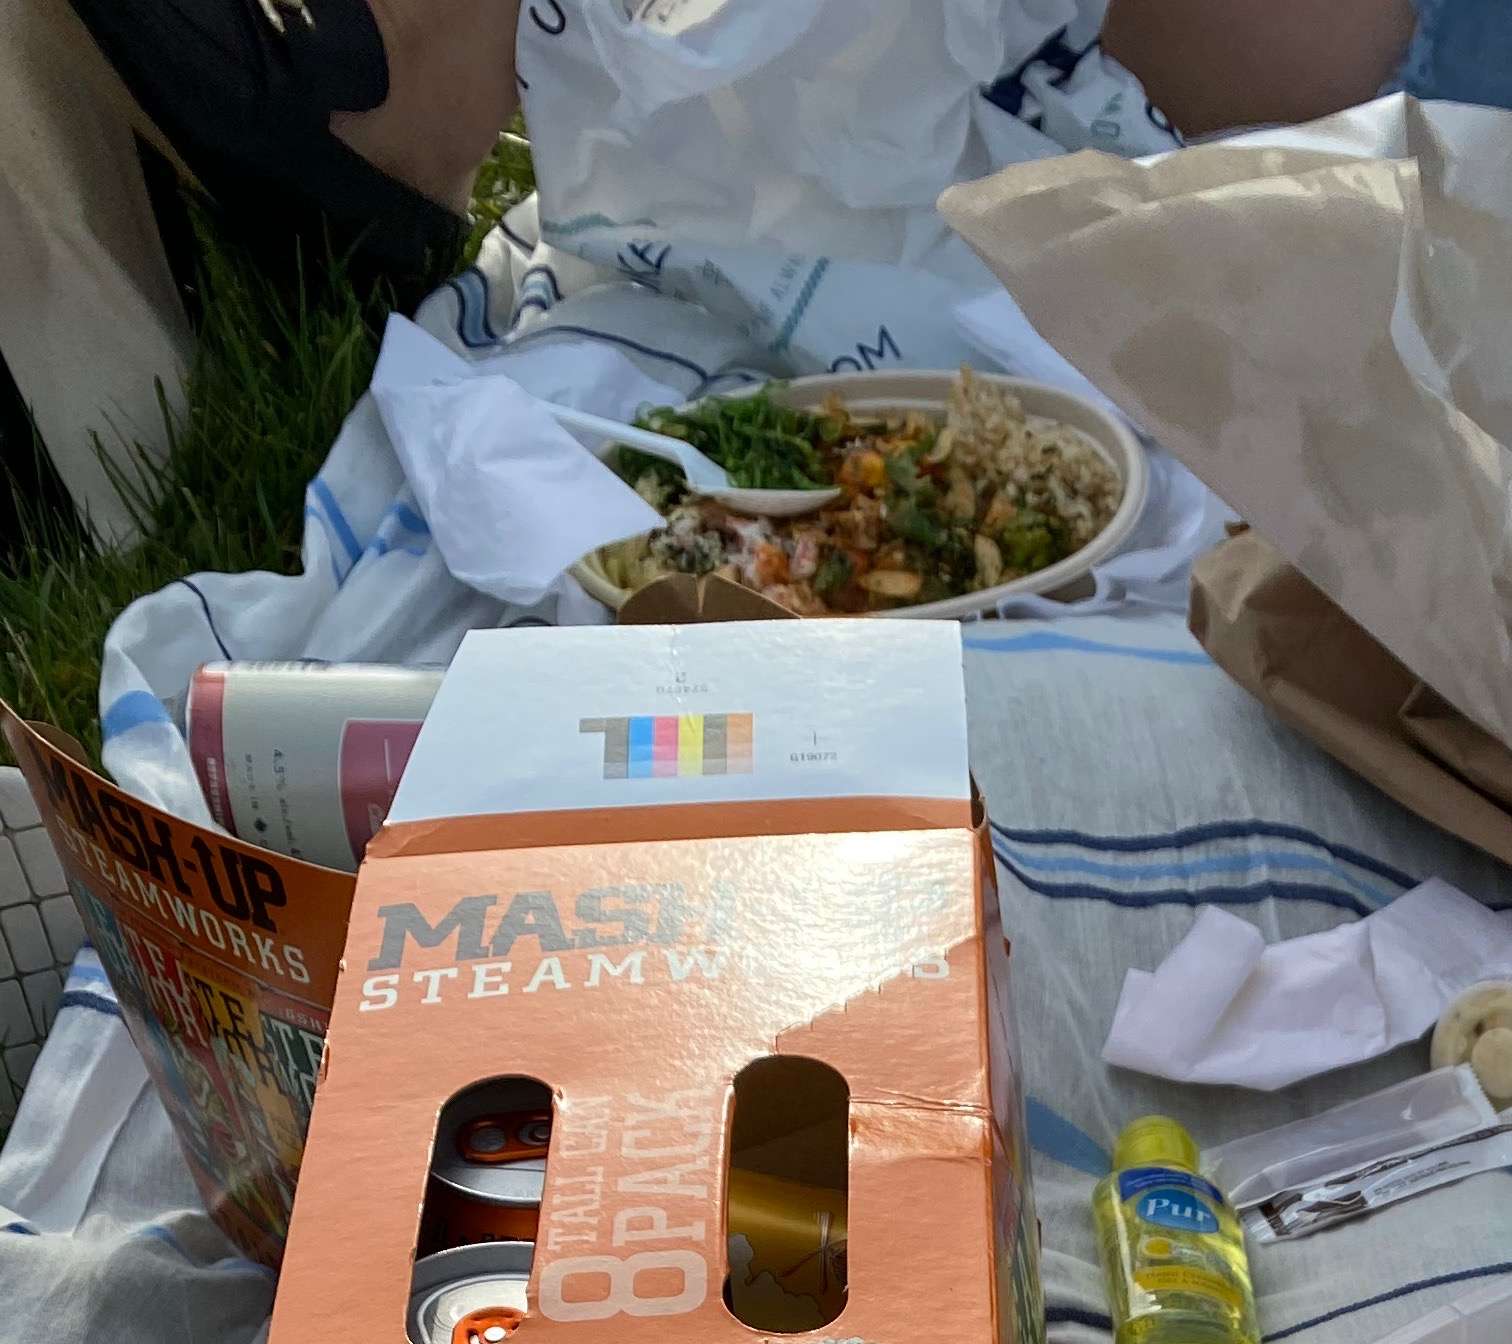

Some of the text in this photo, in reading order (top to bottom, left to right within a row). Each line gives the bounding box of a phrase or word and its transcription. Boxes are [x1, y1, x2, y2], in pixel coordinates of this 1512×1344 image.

[28, 737, 287, 933] MASH-UP
[56, 815, 311, 984] STEAMWORKS
[538, 1087, 717, 1322] 8 PACK
[548, 1167, 604, 1251] TALL
